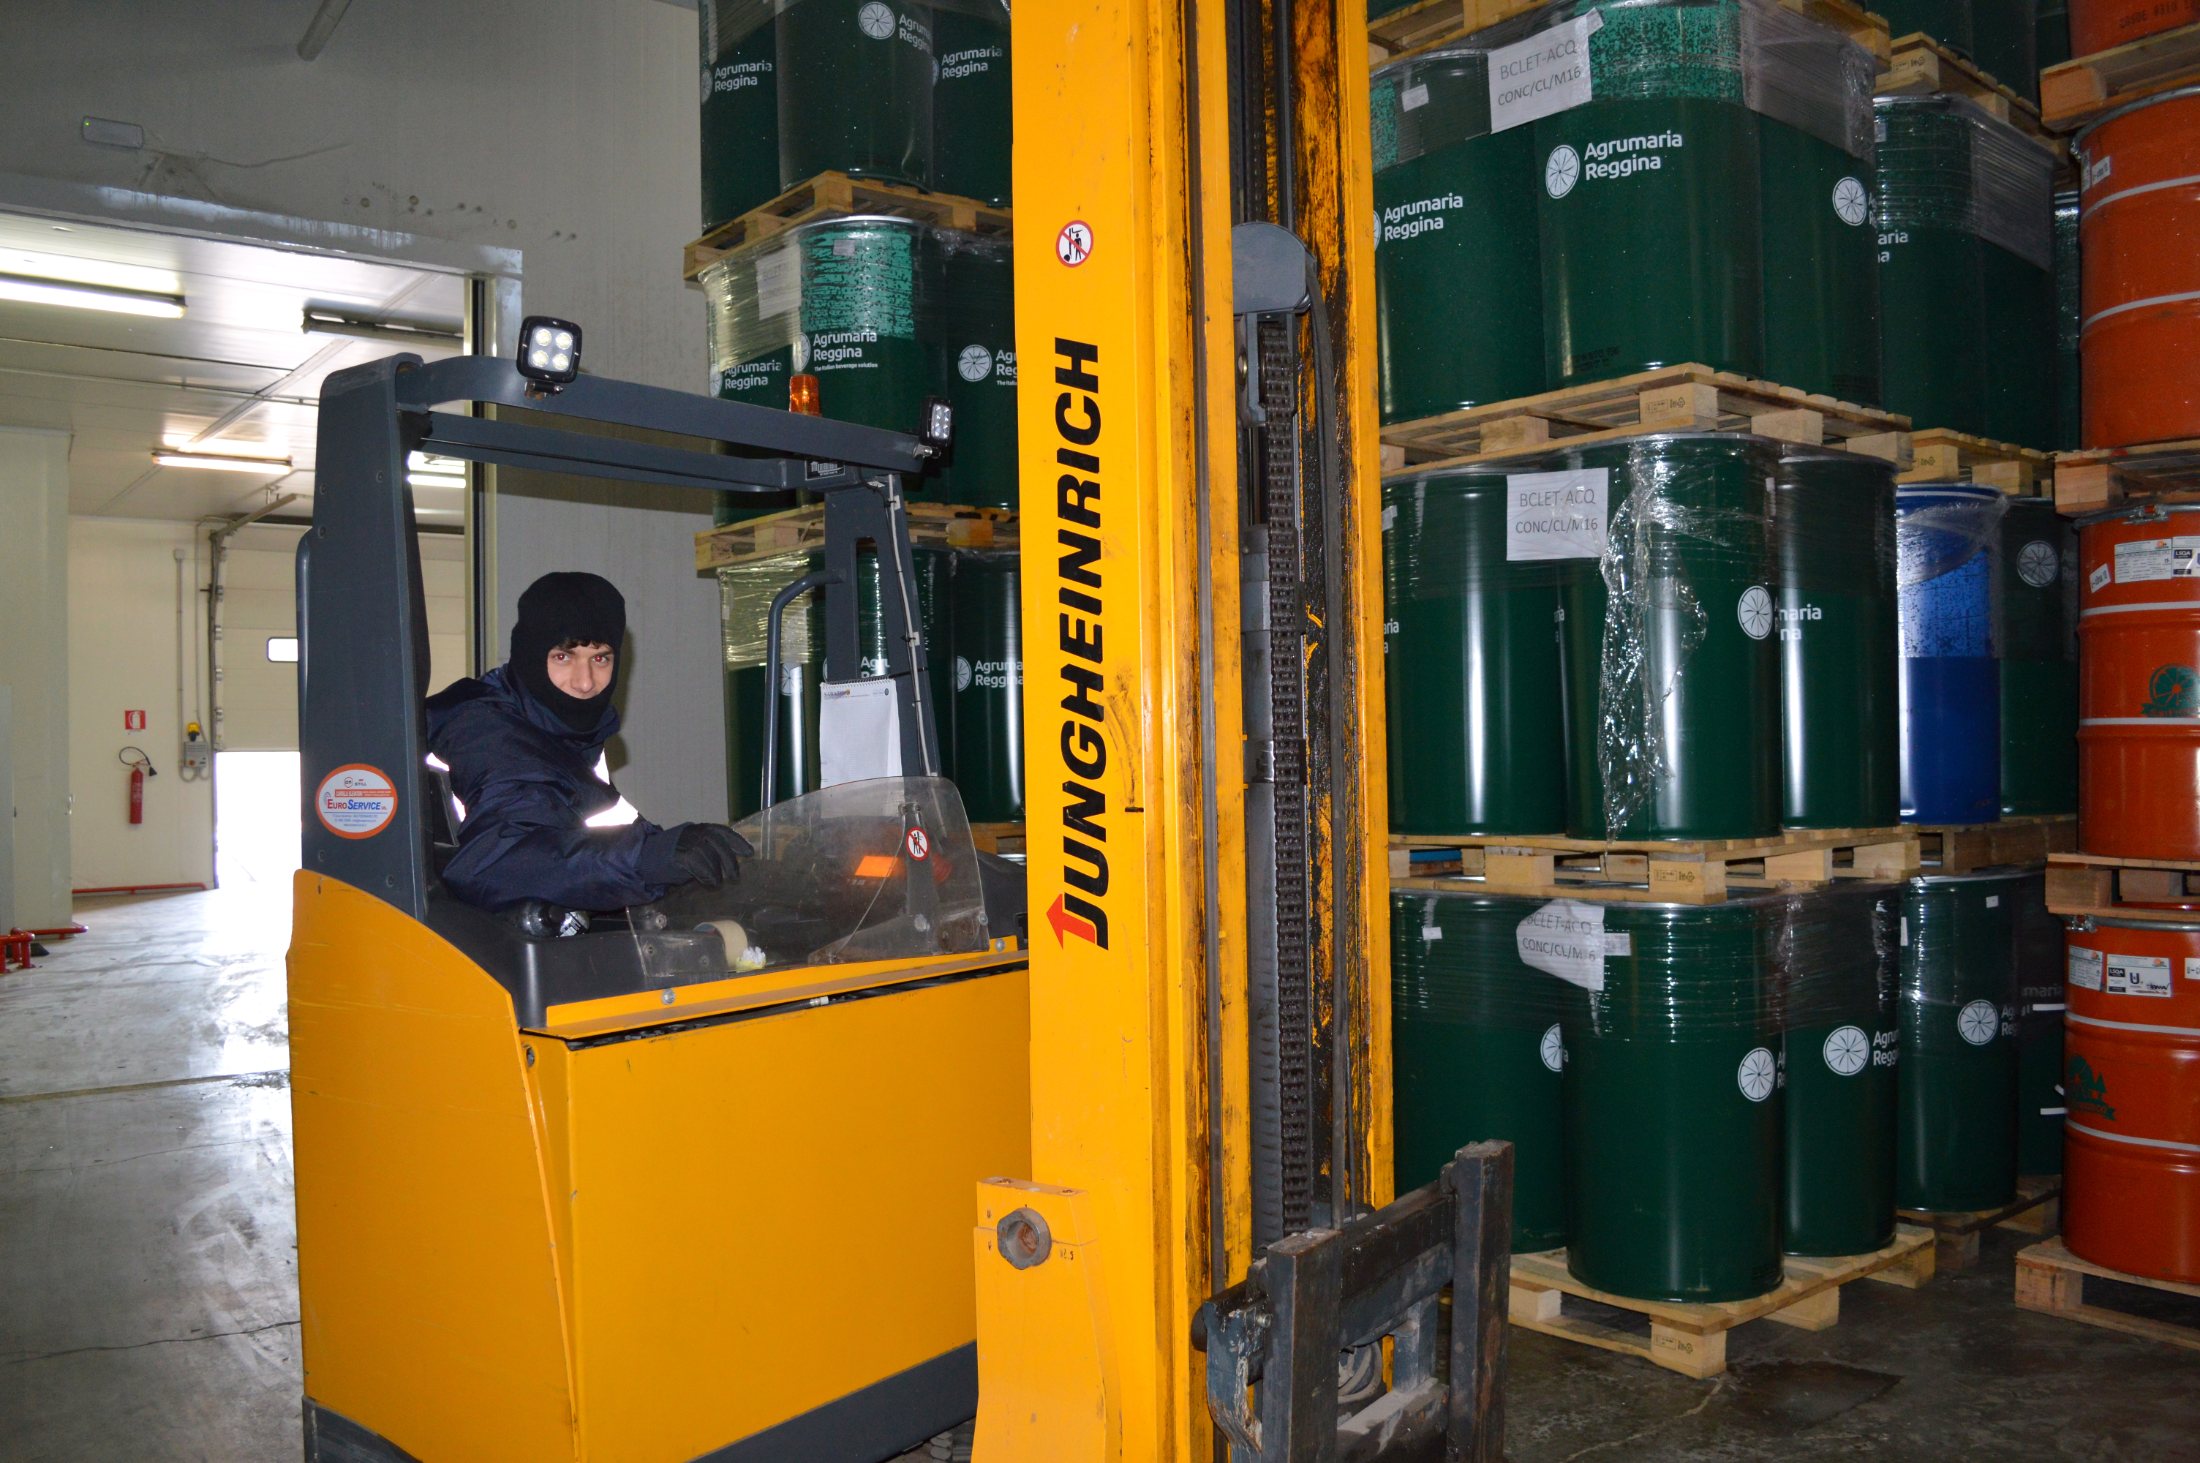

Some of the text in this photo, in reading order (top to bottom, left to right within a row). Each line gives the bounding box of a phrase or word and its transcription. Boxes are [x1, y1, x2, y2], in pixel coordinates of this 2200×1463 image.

[941, 45, 1003, 66] Agrumaria
[1500, 40, 1577, 80] BCLET-ACQ
[714, 60, 773, 79] Agrumaria
[942, 61, 989, 79] Reggina
[714, 74, 758, 92] Reggina
[1498, 66, 1581, 106] CONC/CL/M16
[1584, 130, 1683, 161] Agrumaria
[1585, 154, 1661, 181] Reggina
[1384, 192, 1463, 223] Agrumaria
[1384, 216, 1444, 241] Reggina
[813, 331, 878, 348] Agrumaria
[813, 346, 862, 363] Reggina
[724, 359, 782, 377] Agrumaria
[724, 374, 769, 390] Reggina
[1520, 489, 1596, 507] BCLET-ACQ
[1054, 337, 1109, 951] JUNGHEINRICH
[975, 660, 1023, 674] Agruma
[1522, 937, 1596, 961] CONC/CL/M6
